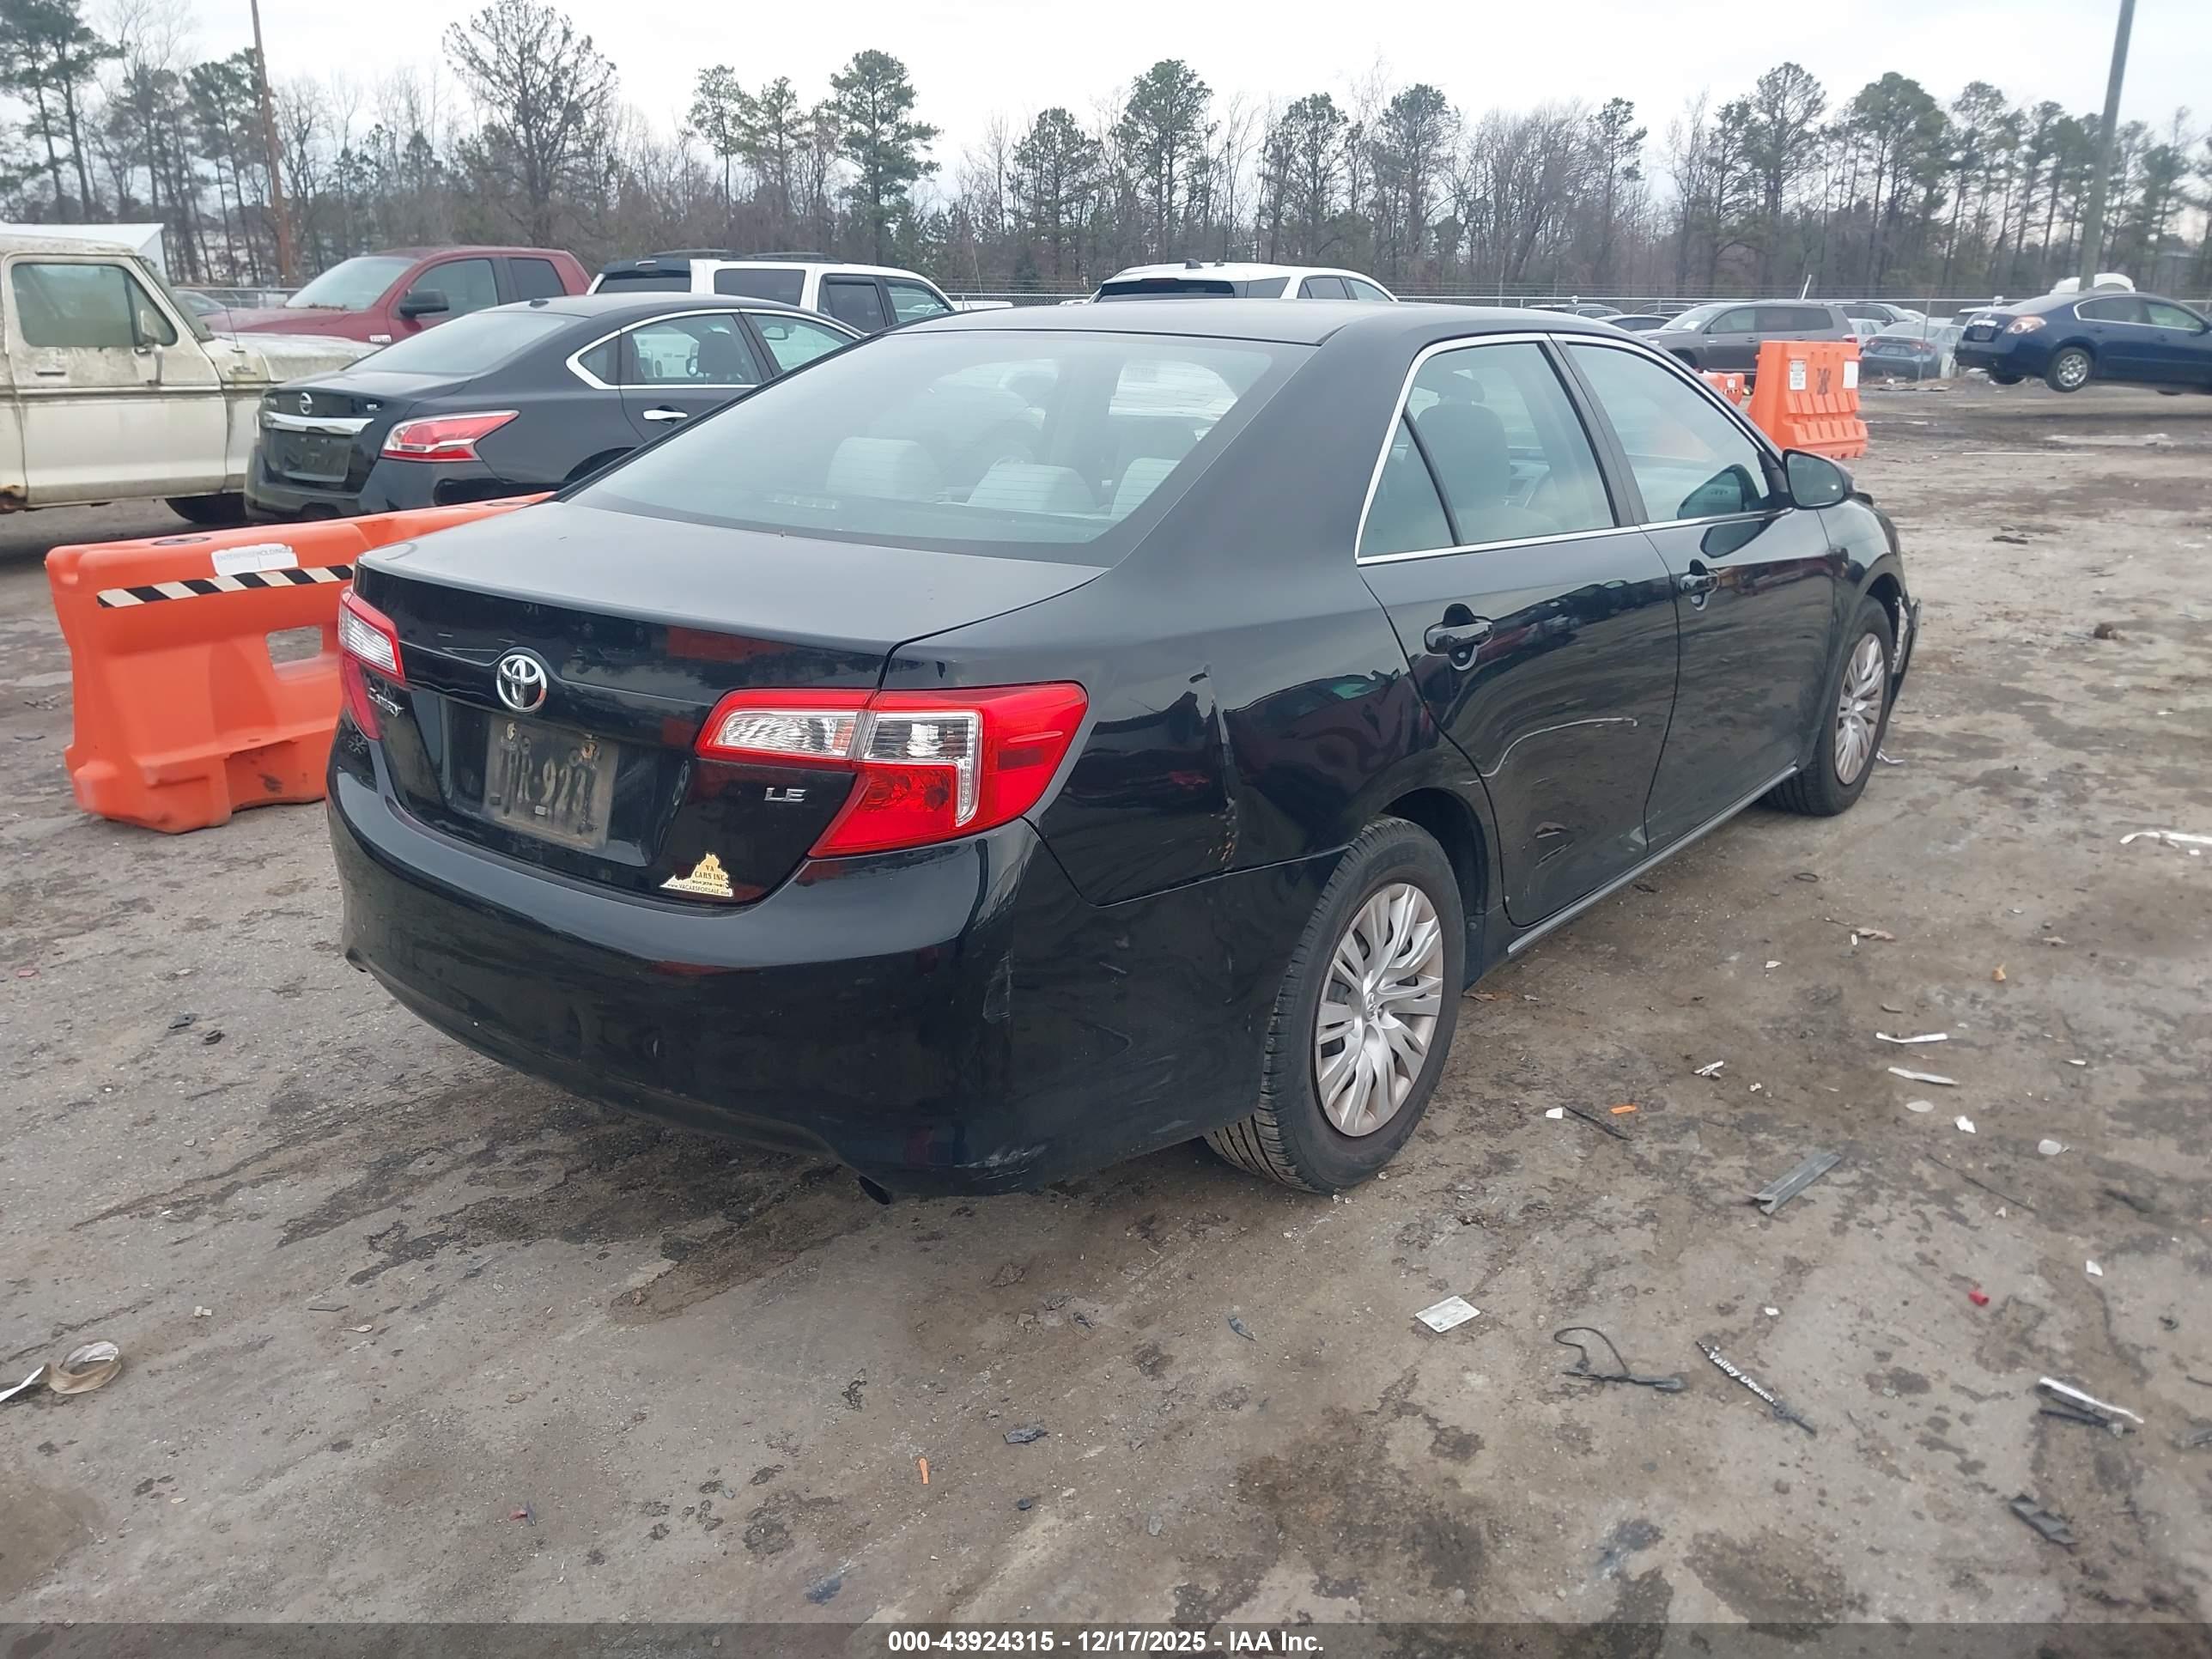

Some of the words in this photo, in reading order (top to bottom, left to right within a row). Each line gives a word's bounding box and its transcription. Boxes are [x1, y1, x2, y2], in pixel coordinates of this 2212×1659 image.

[764, 787, 806, 803] LE
[695, 871, 712, 879] CARS
[1709, 1352, 1741, 1377] Valley
